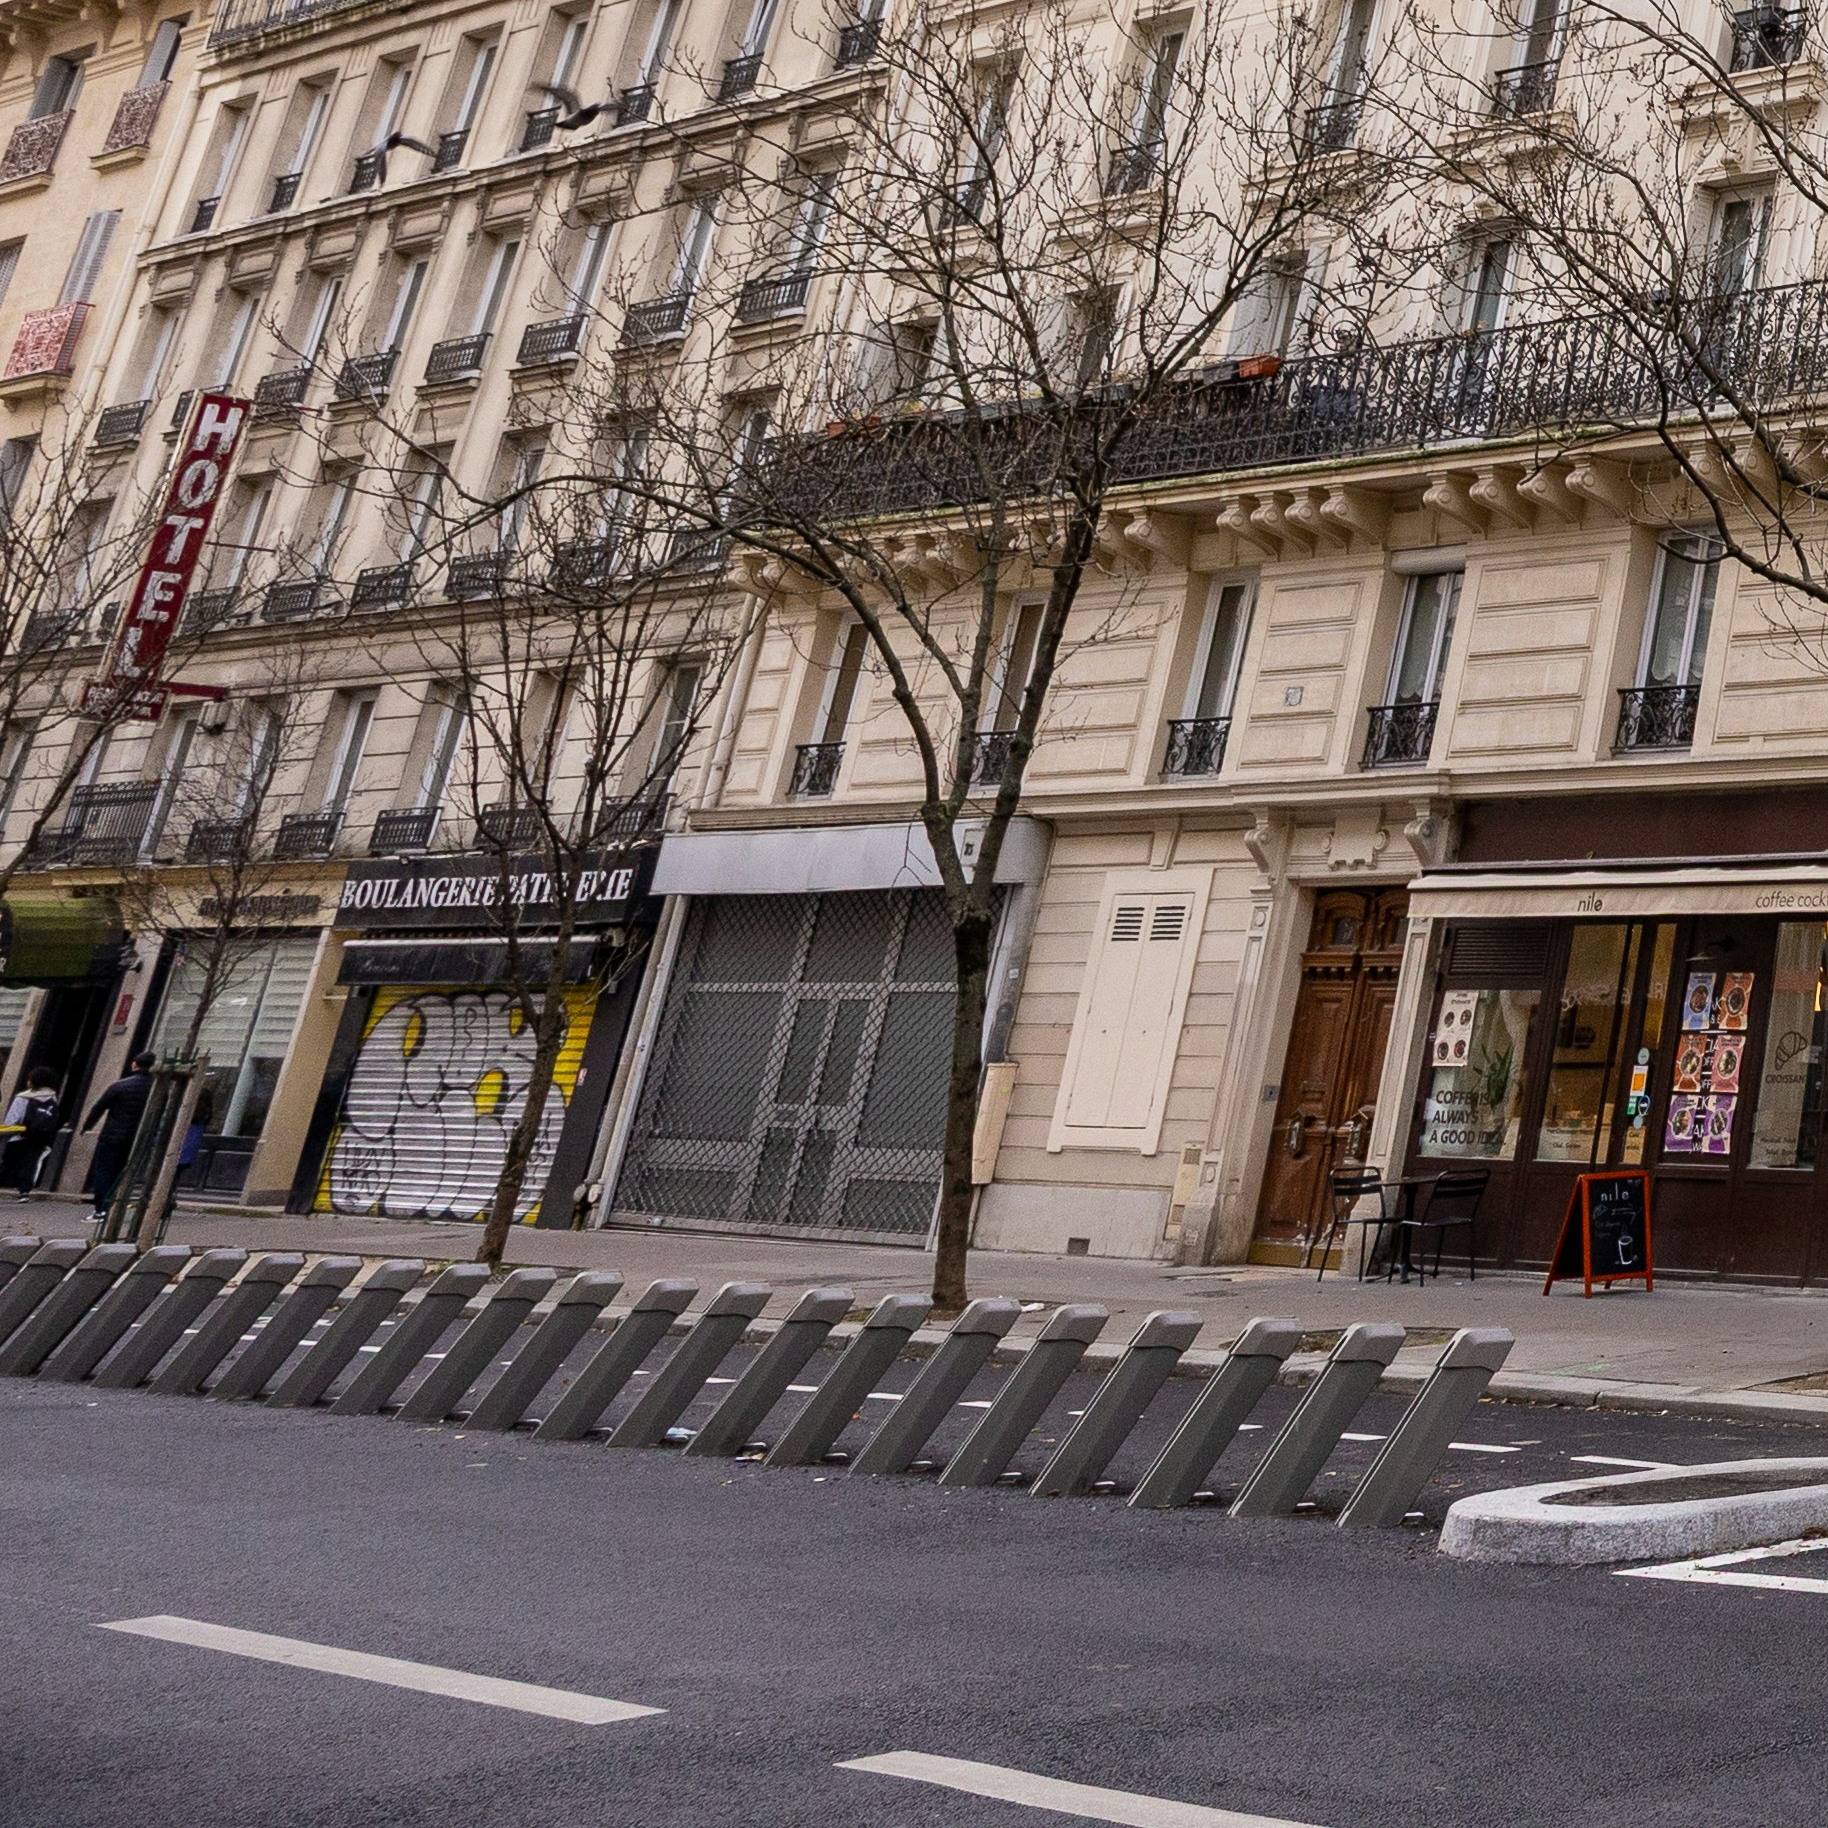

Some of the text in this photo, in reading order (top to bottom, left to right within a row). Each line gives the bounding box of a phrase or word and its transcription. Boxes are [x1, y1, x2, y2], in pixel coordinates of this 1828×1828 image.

[113, 403, 244, 678] HOTEL
[340, 875, 500, 909] BOULANGERIE
[1755, 891, 1795, 908] coffee
[1432, 1109, 1479, 1124] ALWAYS
[1429, 1131, 1438, 1144] A
[1440, 1130, 1475, 1145] GOOD
